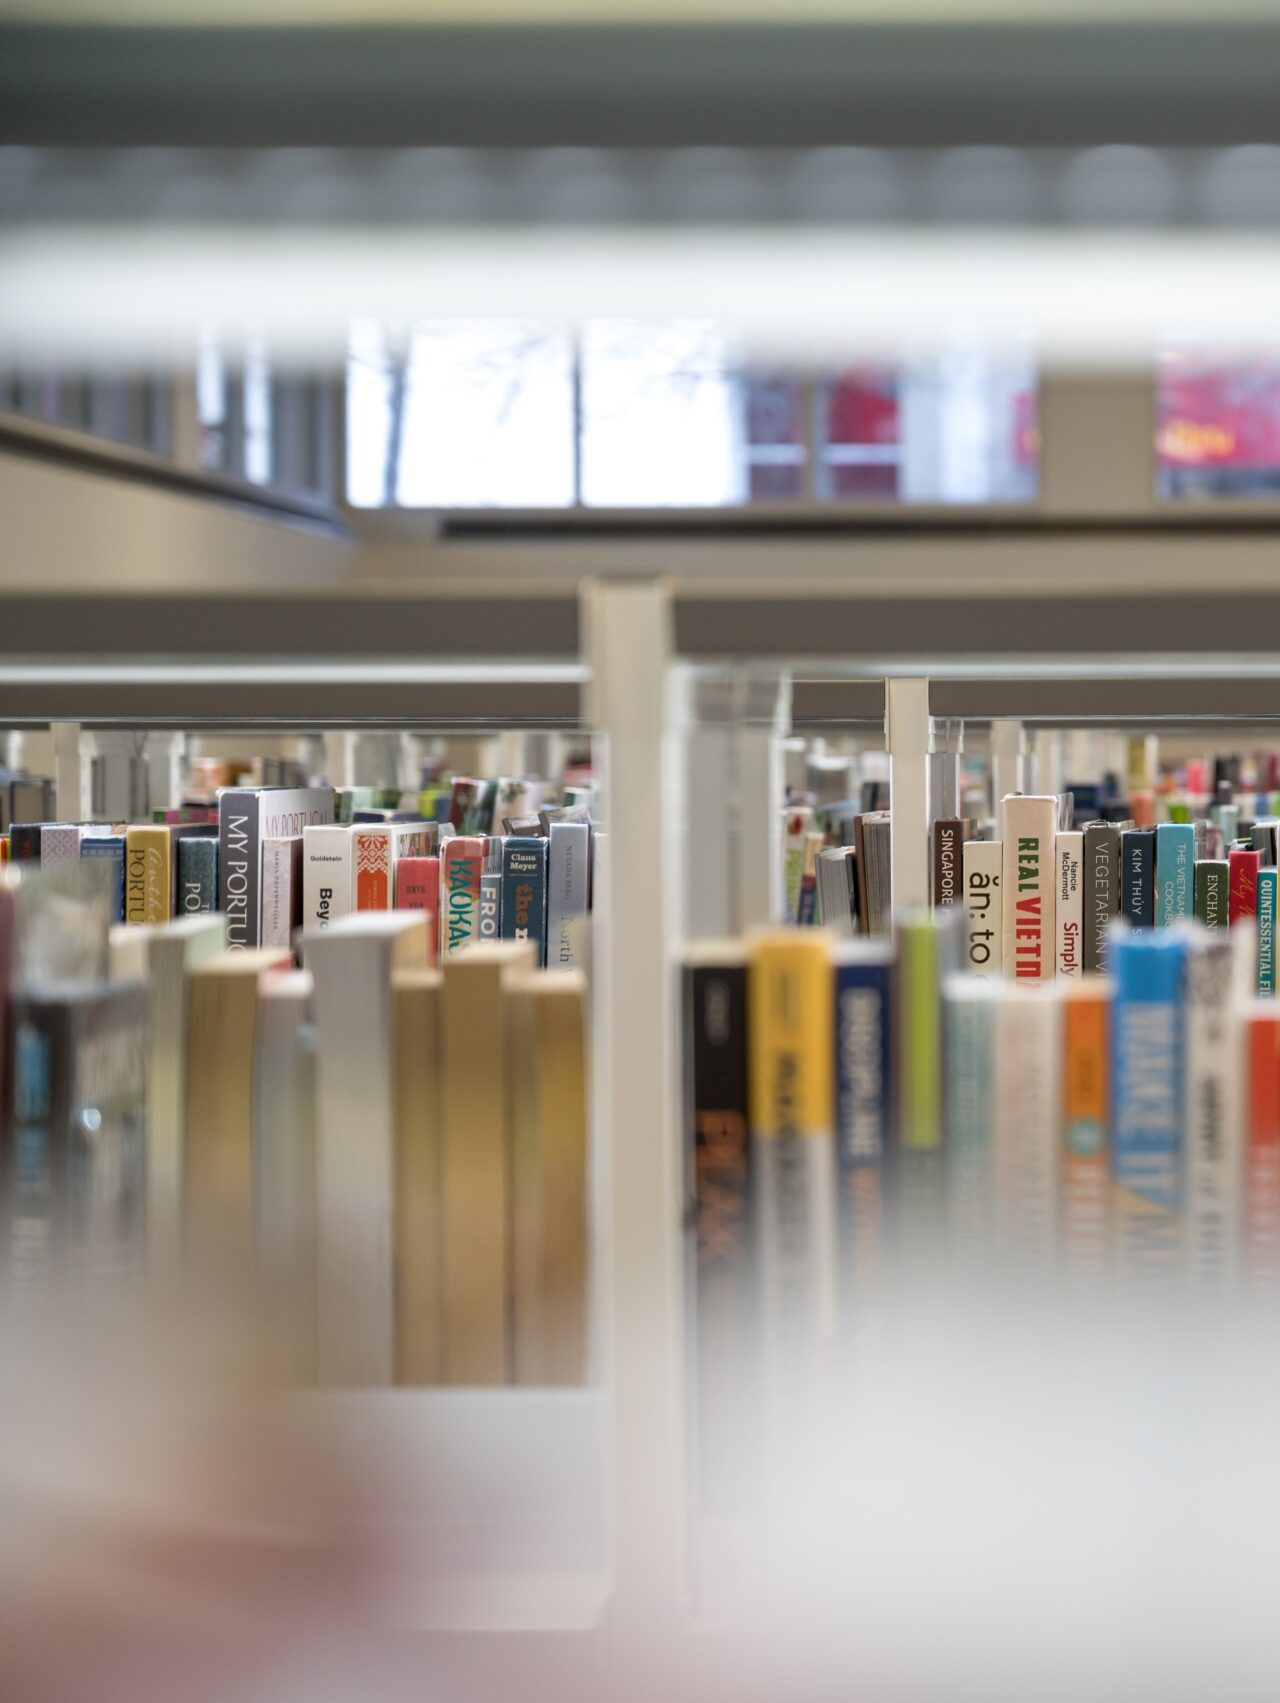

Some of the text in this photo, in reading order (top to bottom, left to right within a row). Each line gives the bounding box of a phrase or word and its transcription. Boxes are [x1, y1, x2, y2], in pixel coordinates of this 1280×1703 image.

[227, 815, 248, 854] MY
[511, 853, 536, 861] Claus
[1177, 843, 1186, 864] THE
[510, 862, 537, 871] Meyer
[941, 829, 954, 905] SINGAPORE
[1018, 837, 1040, 892] REAL
[1062, 852, 1070, 900] McDermott
[1070, 861, 1079, 892] Nancie
[1131, 849, 1142, 873] KIM
[128, 849, 145, 926] PORTU
[515, 882, 534, 925] the
[1095, 842, 1109, 954] VEGETARIAN
[1131, 879, 1144, 915] THÚY
[481, 887, 497, 944] FRO
[1260, 879, 1273, 977] QUINTESSENTIAL
[559, 915, 574, 963] North
[969, 929, 994, 964] to
[1060, 922, 1079, 978] Simply
